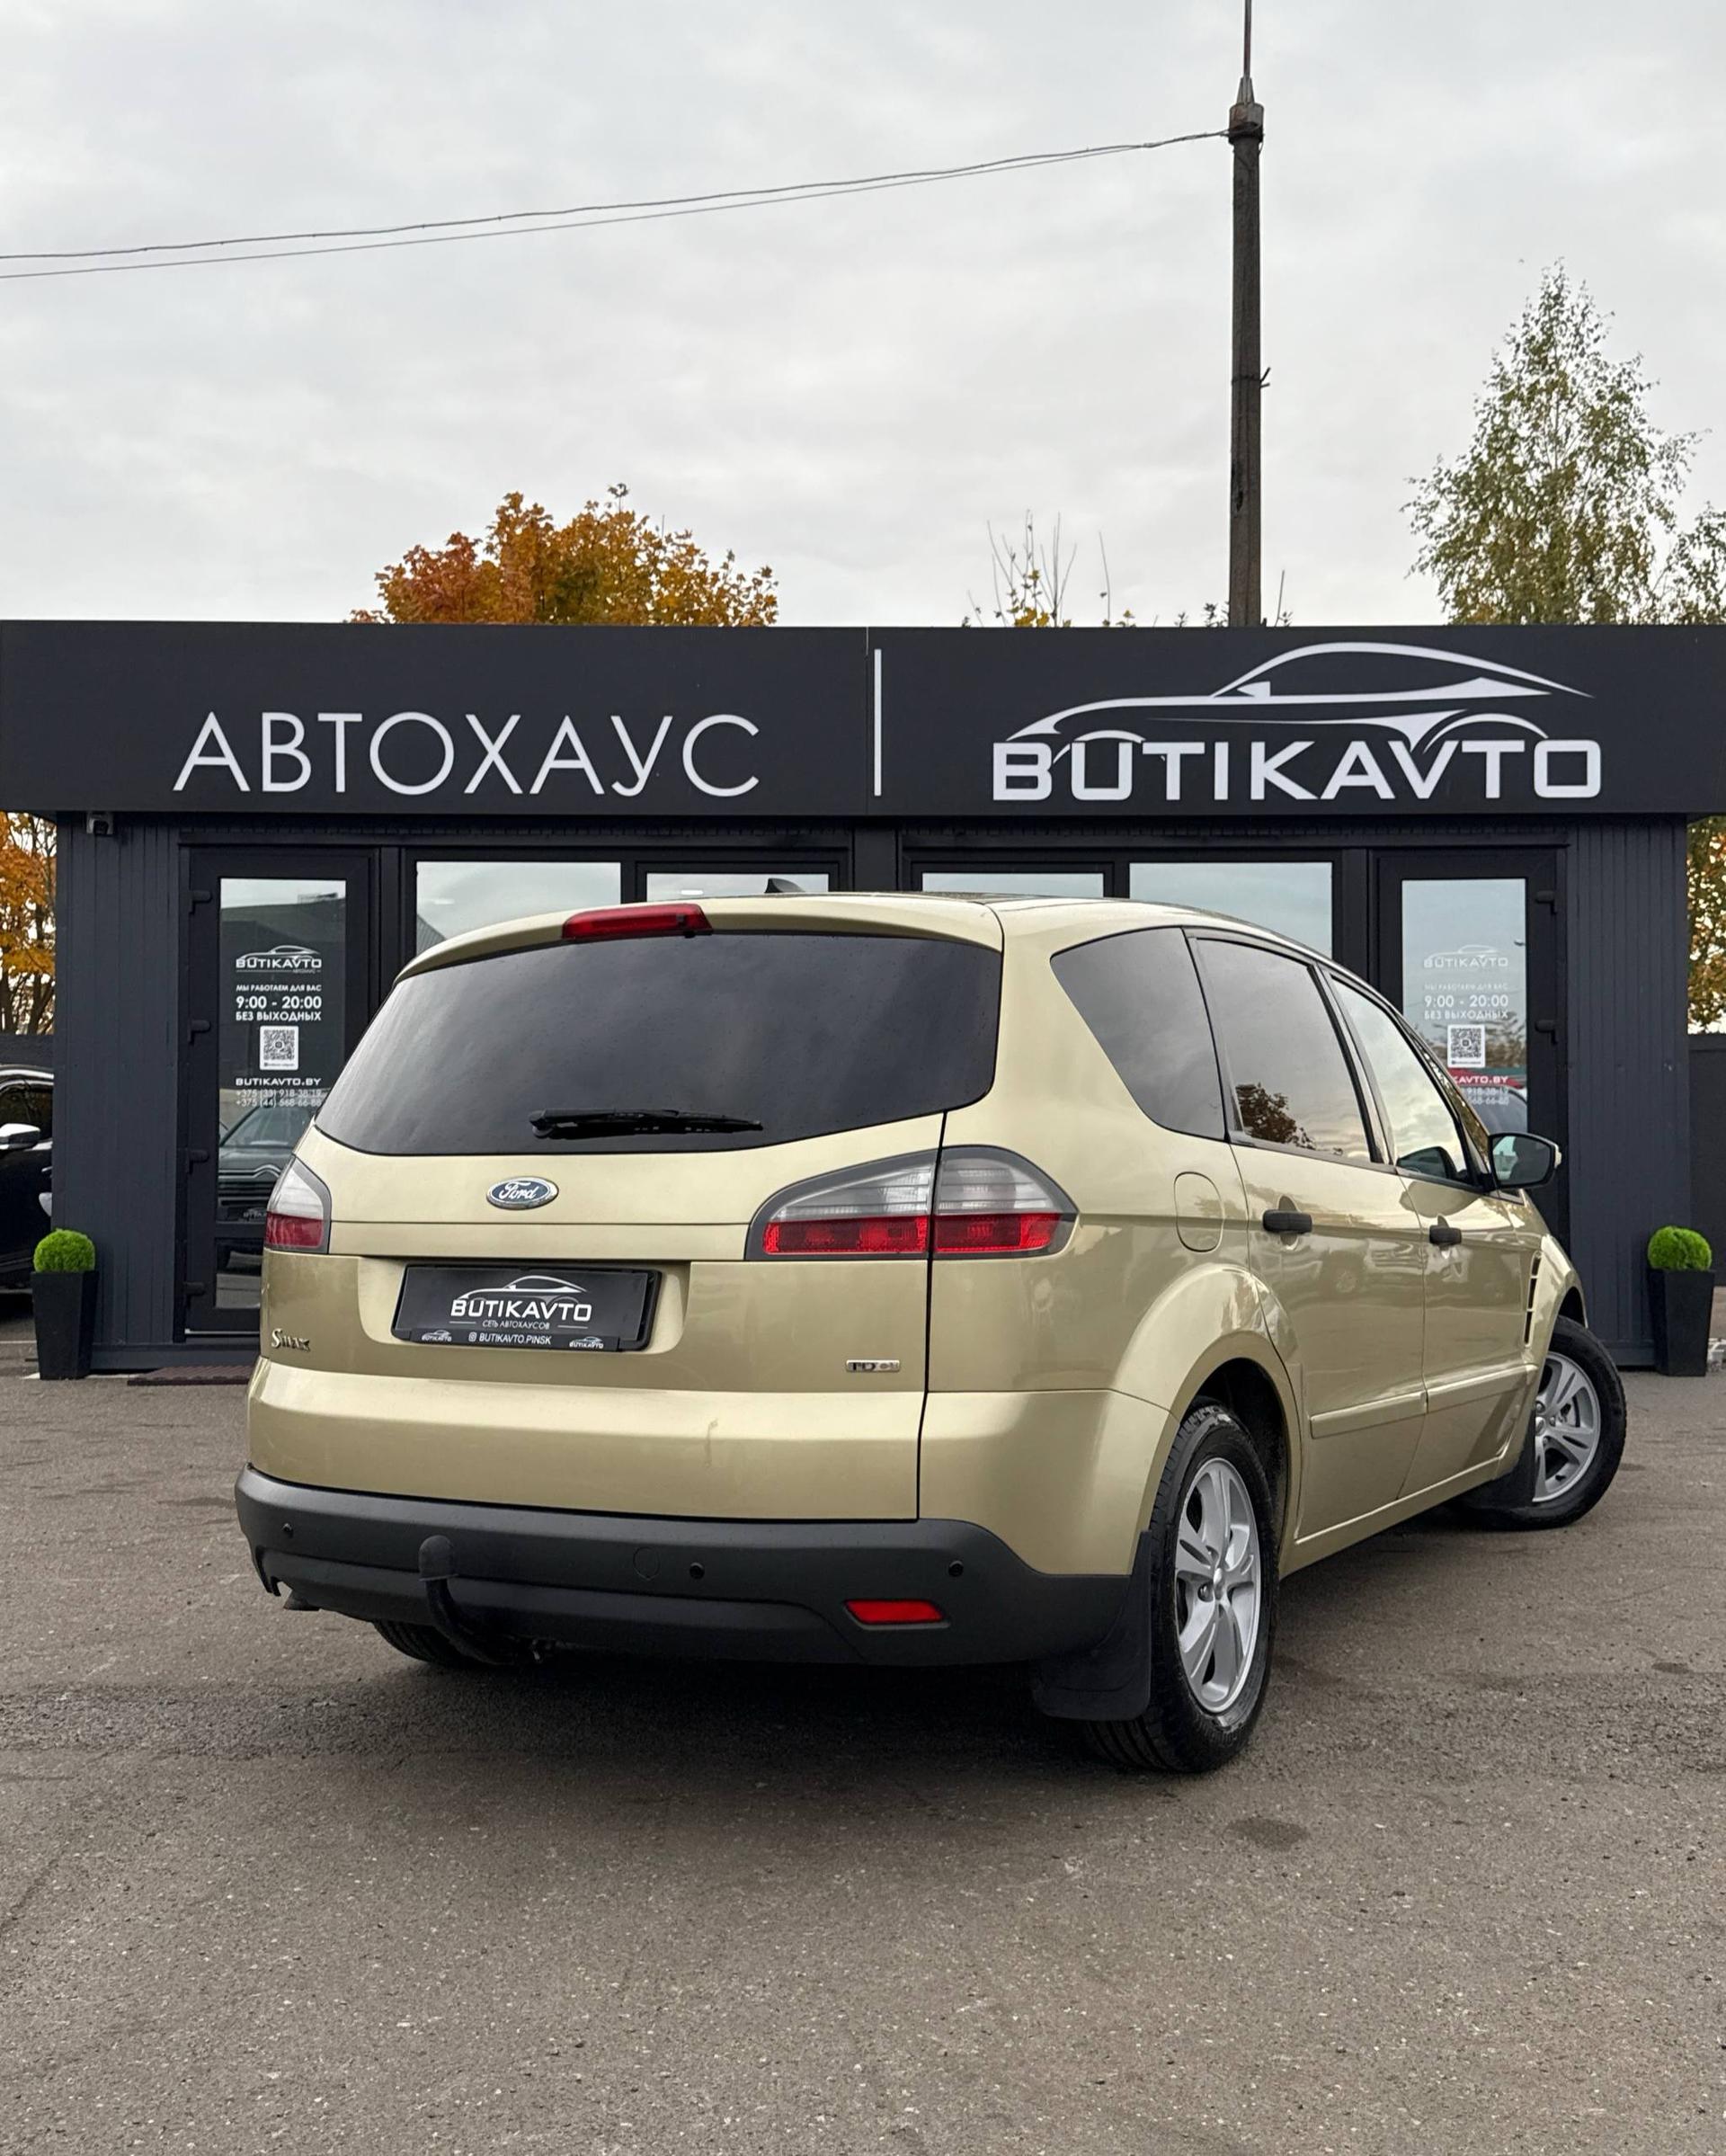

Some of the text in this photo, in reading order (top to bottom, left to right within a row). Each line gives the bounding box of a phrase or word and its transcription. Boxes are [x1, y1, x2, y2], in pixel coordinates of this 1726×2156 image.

[172, 711, 760, 797] АВТОХАУС
[992, 739, 1601, 800] BUTIKAVTO
[236, 958, 322, 968] BUTIKAVTO
[1423, 958, 1508, 967] BUTIKAVTO
[236, 984, 250, 992] МЫ
[250, 984, 289, 992] РАБОТАЕМ
[306, 984, 322, 992] ВАС
[236, 995, 267, 1009] 9:00
[281, 995, 322, 1009] 20:00
[1424, 994, 1455, 1007] 9:00
[1469, 994, 1508, 1007] 20:00
[236, 1011, 322, 1022] БЕЗ ВЫХОДНЫХ
[1424, 1010, 1508, 1020] БЕЗ ВЫХОДНЫХ
[236, 1078, 322, 1086] BUTIKAVTO.BY
[236, 1089, 257, 1097] +375
[236, 1099, 257, 1107] +375
[499, 1180, 539, 1199] Ford
[450, 1299, 592, 1322] BUTIKAVTO
[482, 1320, 550, 1331] СЕТЬ АВТОХАУСОВ
